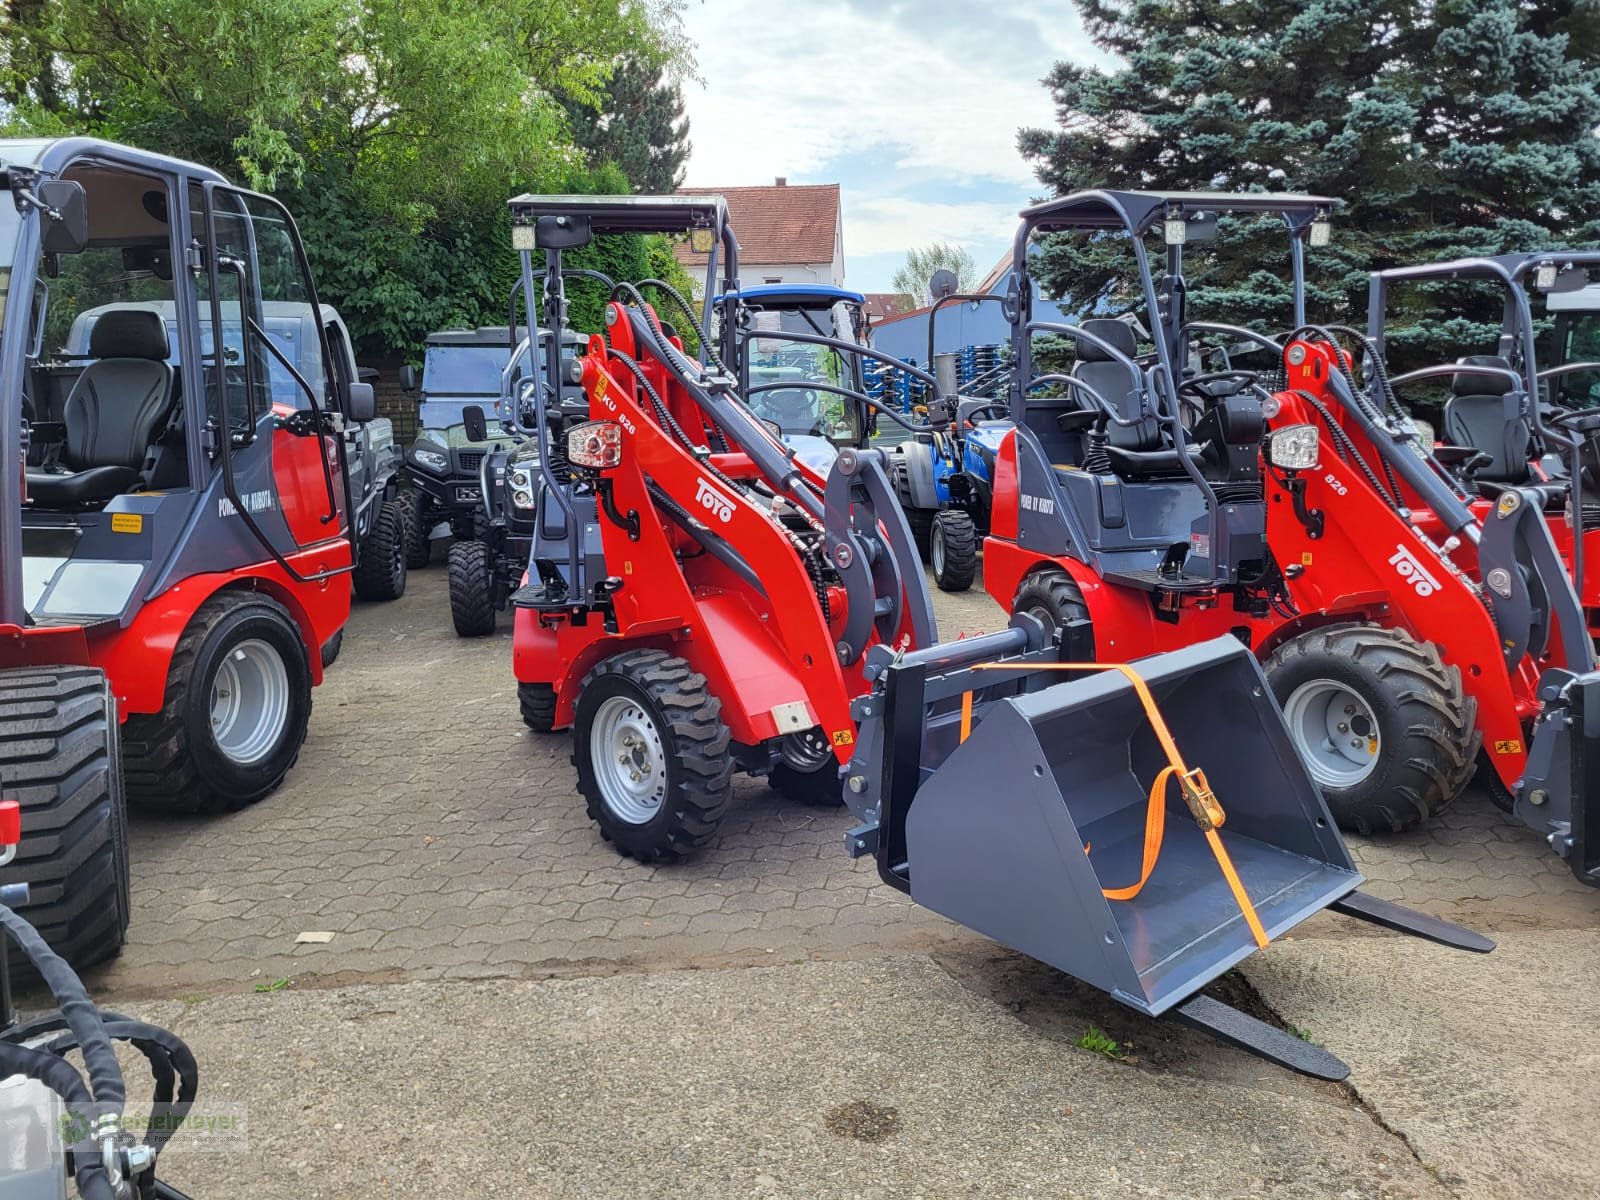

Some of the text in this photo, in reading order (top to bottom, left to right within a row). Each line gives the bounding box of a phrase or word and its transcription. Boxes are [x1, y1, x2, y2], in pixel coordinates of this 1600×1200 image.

[602, 394, 636, 435] KU 826
[251, 489, 272, 512] KUBOTA
[696, 476, 737, 523] TOYO
[1325, 473, 1348, 496] 826
[1387, 543, 1443, 597] TOYO
